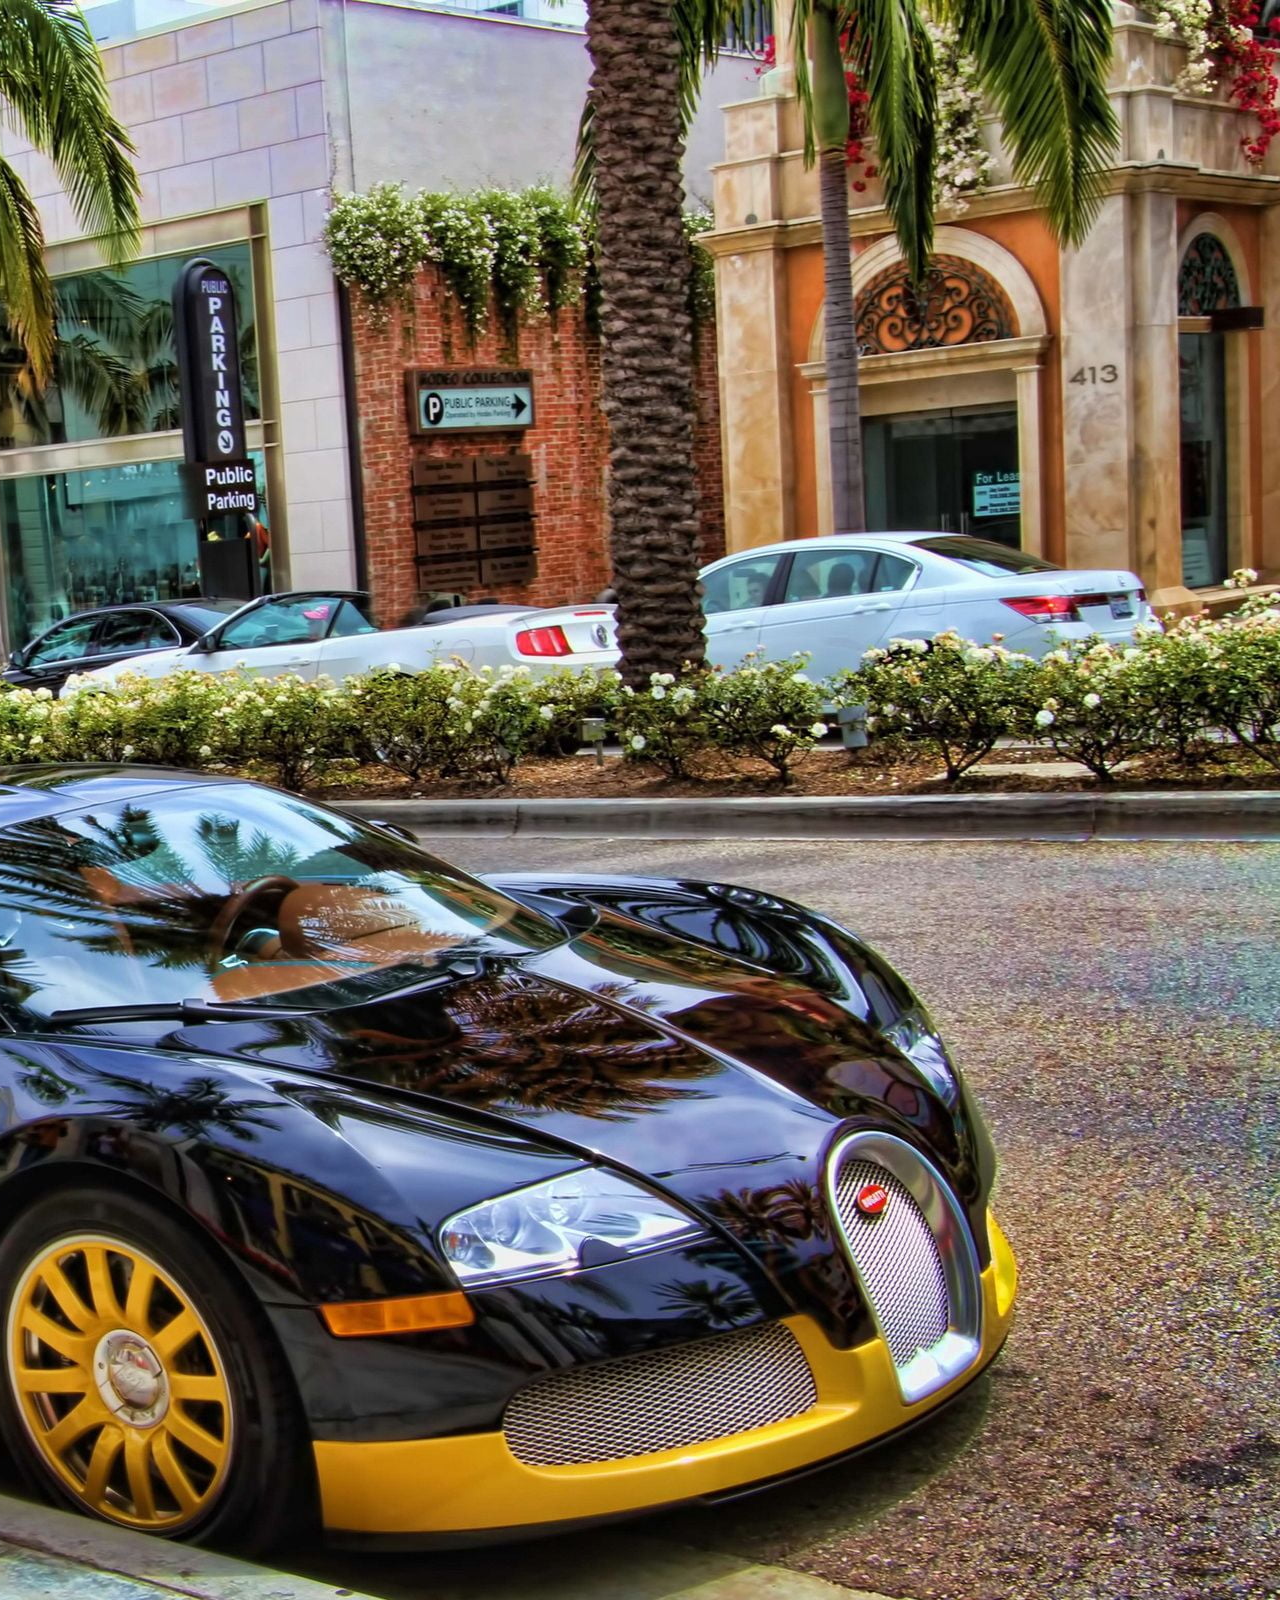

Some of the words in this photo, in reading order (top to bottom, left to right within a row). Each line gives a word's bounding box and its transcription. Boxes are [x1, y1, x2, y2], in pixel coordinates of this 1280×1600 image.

[201, 280, 228, 294] PUBLIC
[208, 296, 232, 427] PARKING
[1068, 364, 1118, 385] 413
[444, 397, 473, 409] PUBLIC
[475, 396, 511, 408] PARKING
[205, 466, 253, 486] Public
[976, 473, 993, 484] For
[997, 471, 1020, 482] Leas
[207, 491, 255, 511] Parking
